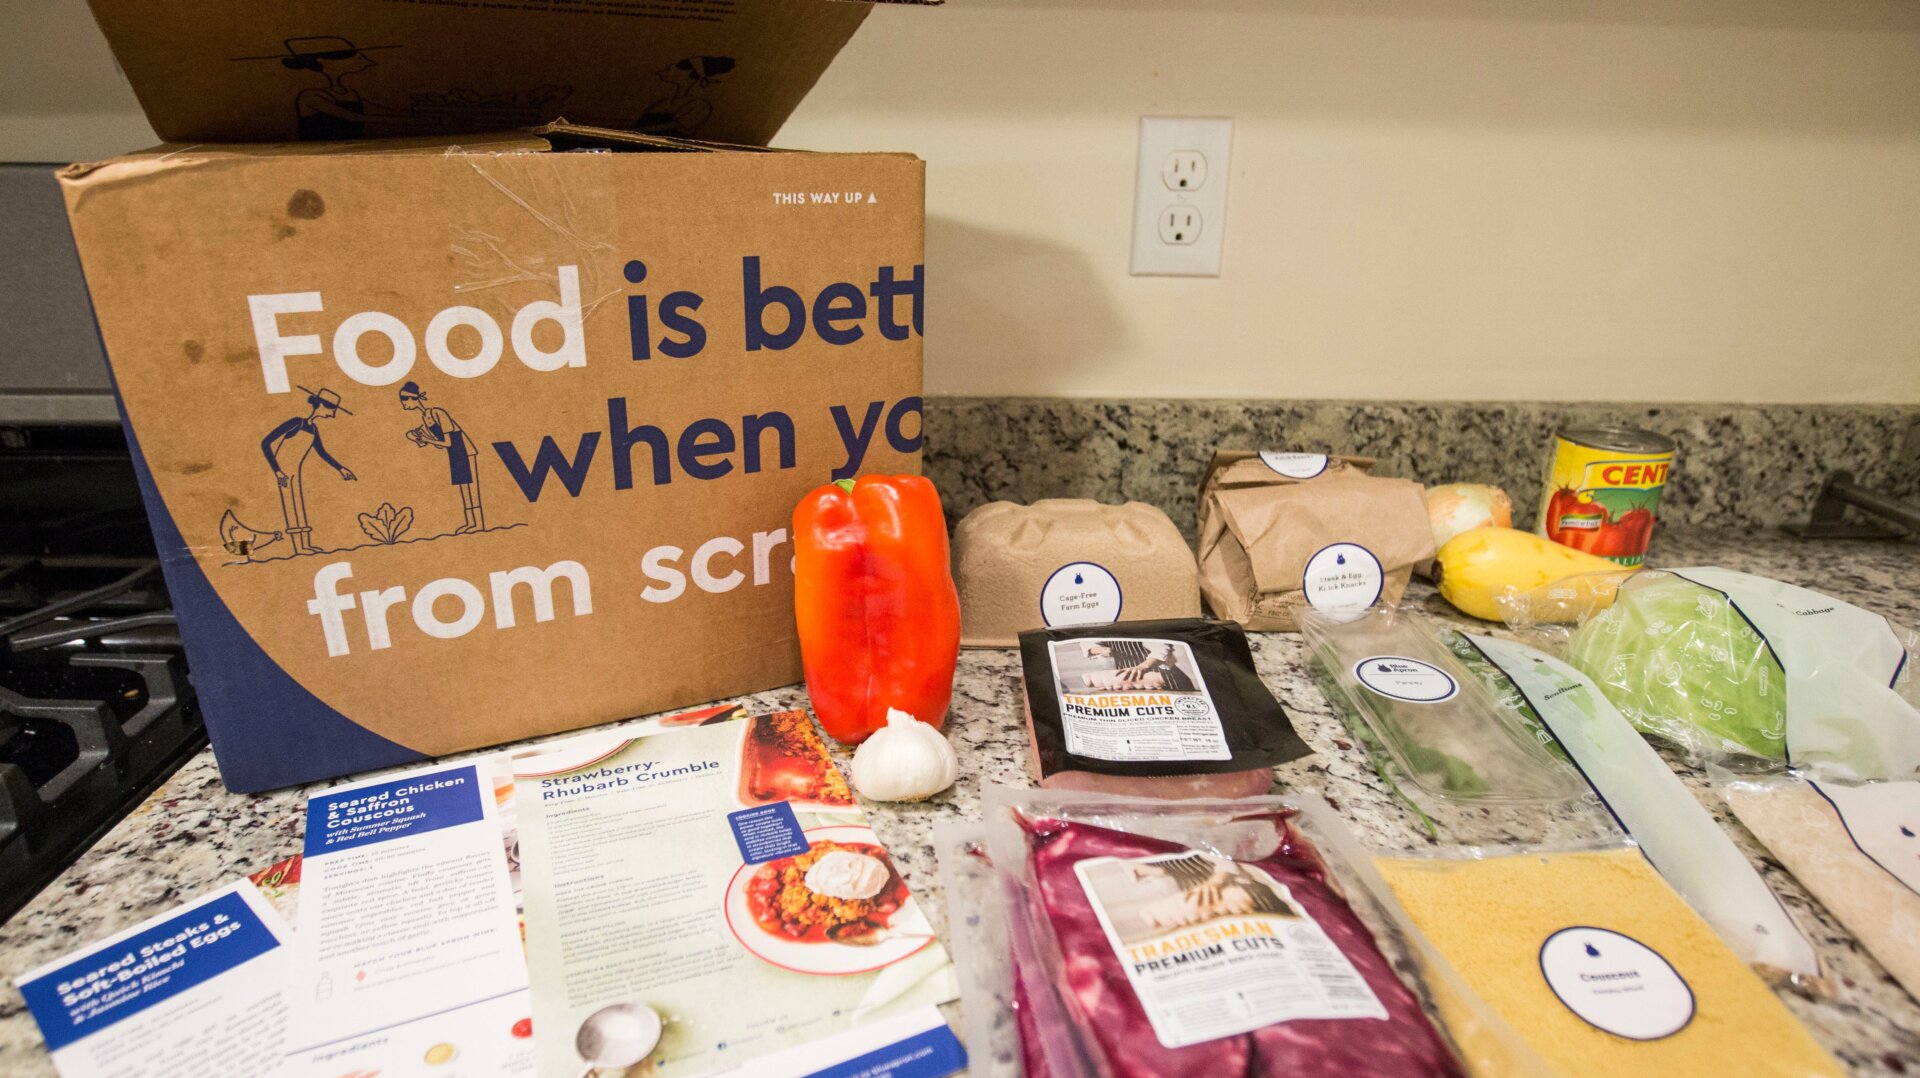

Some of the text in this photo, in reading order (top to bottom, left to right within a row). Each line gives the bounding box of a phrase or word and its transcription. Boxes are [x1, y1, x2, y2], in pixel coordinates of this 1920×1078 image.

[773, 192, 862, 204] THIS WAY UP
[247, 256, 924, 395] Food is bett
[493, 397, 923, 503] when yo
[1602, 464, 1669, 486] CENT
[1340, 580, 1367, 590] Knacks
[1348, 571, 1362, 580] Egg
[307, 527, 796, 658] from scr
[1059, 591, 1098, 603] Cage-Free
[1061, 600, 1100, 612] Farm Eggs
[1795, 607, 1835, 617] Cabbage
[1064, 695, 1171, 708] TRADESMAN
[1543, 681, 1583, 701] Scallions
[1063, 713, 1098, 722] PREMIUM
[1066, 704, 1130, 717] PREMIUM
[1136, 705, 1174, 716] CUTS
[541, 760, 661, 789] Strawberry-
[543, 777, 629, 800] Rhubarb
[636, 759, 720, 782] Crumble
[327, 777, 465, 811] Seared Chicken
[327, 804, 415, 829] Couscous
[328, 797, 410, 820] & Saffron
[326, 812, 427, 838] with Summer Squash
[335, 833, 356, 843] Red
[357, 828, 376, 838] Bell
[378, 822, 413, 835] Pepper
[1128, 921, 1276, 961] TRADESMAN
[57, 913, 230, 996] Seared Steaks &
[62, 921, 242, 1007] Soft-Boiled Eggs
[1135, 943, 1225, 976] PREMIUM
[1231, 937, 1284, 952] CUTS
[70, 997, 101, 1017] with
[101, 979, 140, 1003] Quick
